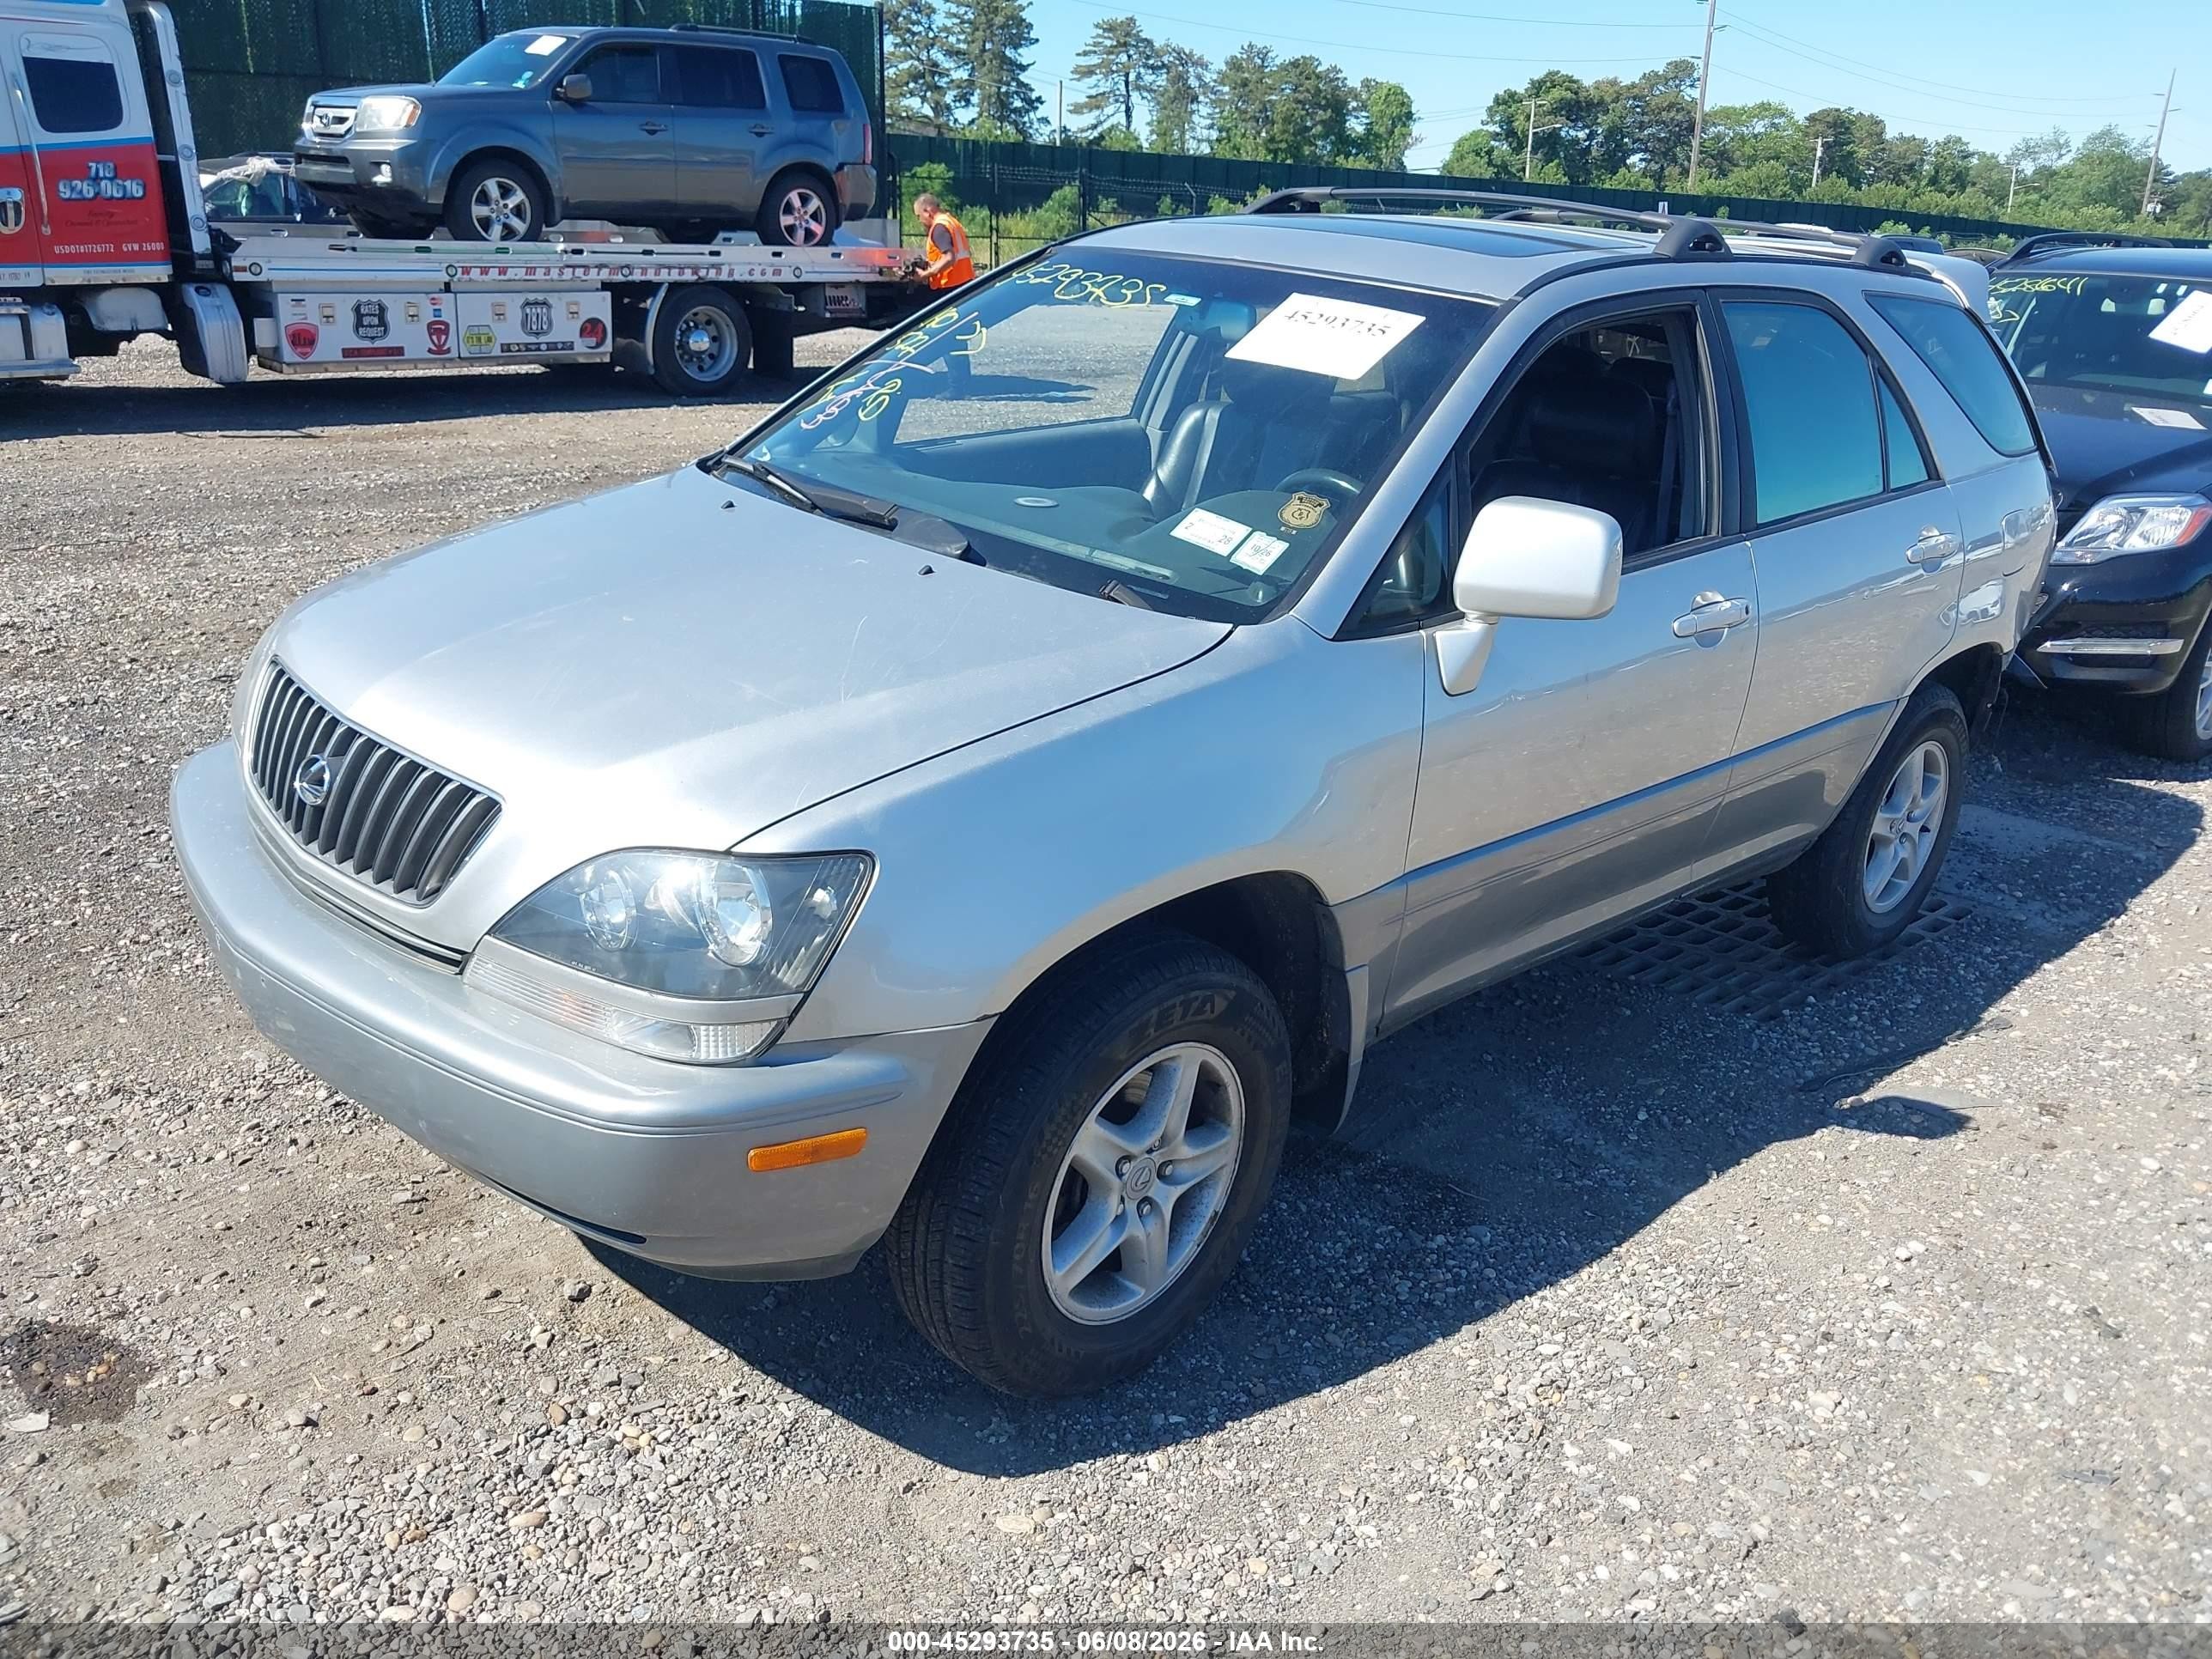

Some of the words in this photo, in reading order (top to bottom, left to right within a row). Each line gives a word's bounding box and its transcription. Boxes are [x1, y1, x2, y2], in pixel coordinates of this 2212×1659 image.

[88, 161, 116, 179] 718
[122, 242, 139, 252] GVW
[360, 305, 380, 314] RATES
[1217, 534, 1233, 545] 28
